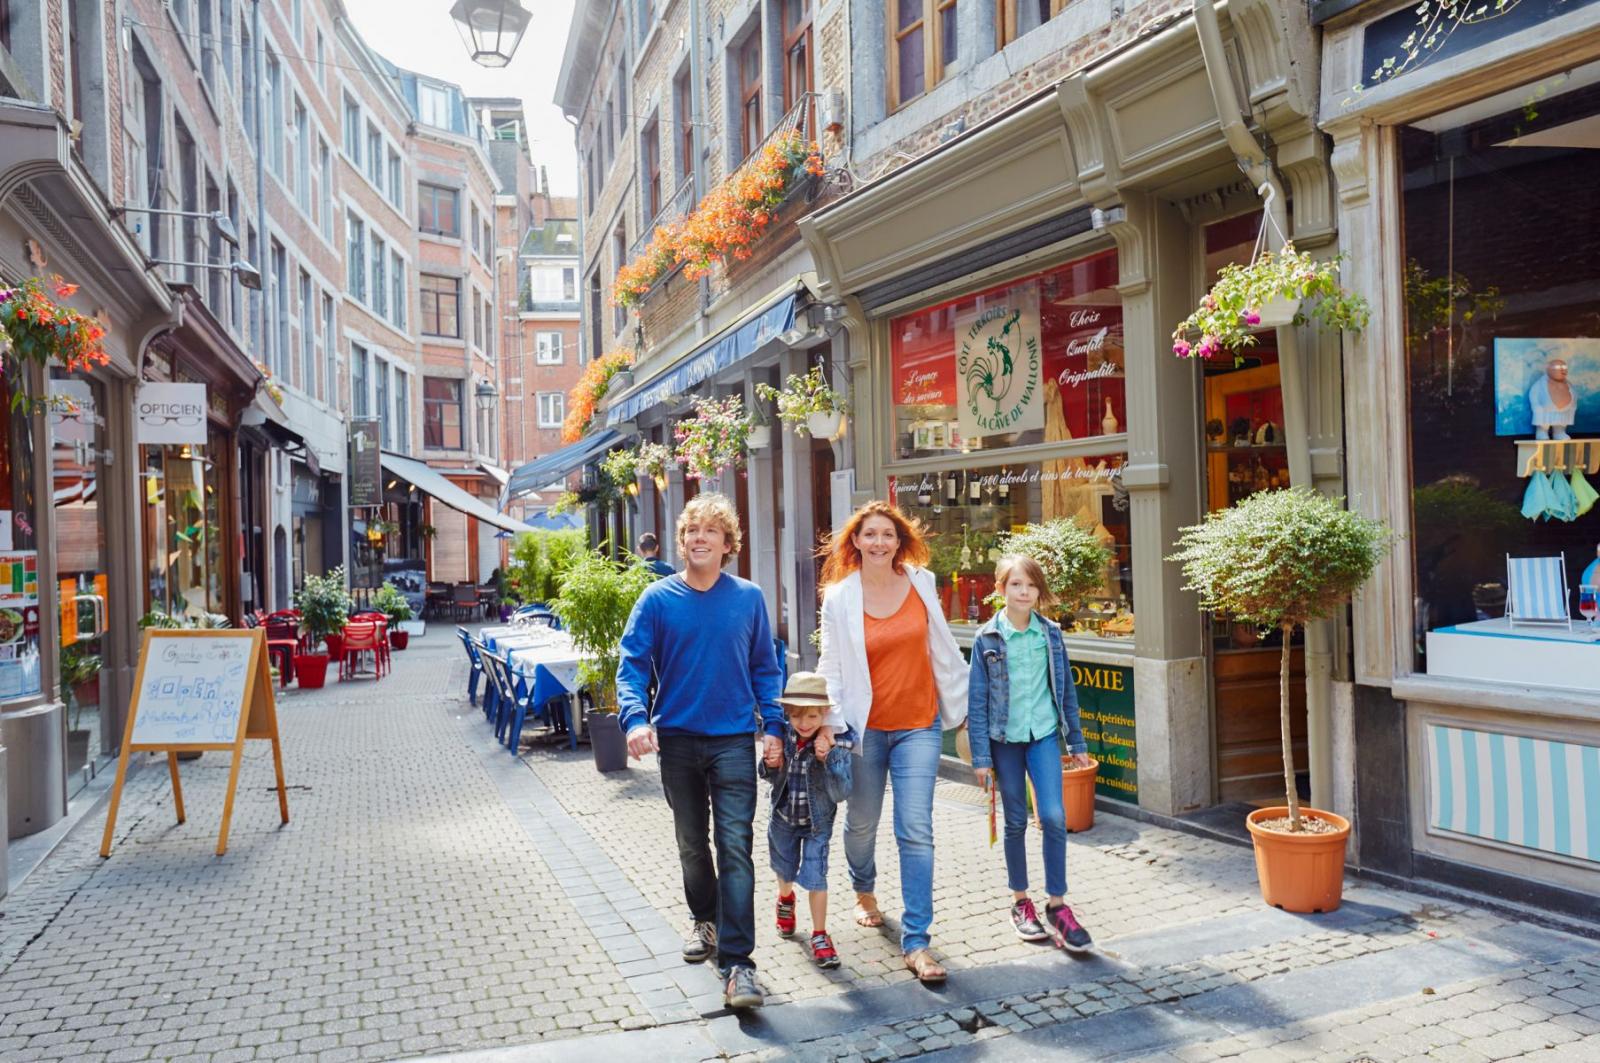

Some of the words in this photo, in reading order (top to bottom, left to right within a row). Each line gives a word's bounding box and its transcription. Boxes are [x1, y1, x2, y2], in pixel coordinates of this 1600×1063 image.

[1069, 309, 1101, 328] Choix
[1058, 361, 1116, 388] Originalité
[977, 415, 987, 429] LA
[988, 414, 1011, 431] CAVE
[1010, 404, 1024, 422] DE
[1020, 336, 1039, 405] WALLONIE
[140, 403, 203, 415] OPTICIEN
[1000, 469, 1028, 485] alcools
[1030, 470, 1040, 483] et
[1041, 472, 1058, 481] vins
[1061, 465, 1072, 479] de
[1075, 466, 1094, 478] tous
[1096, 711, 1135, 727] Apéritives
[1101, 731, 1136, 748] Cadeaux
[1106, 754, 1137, 769] Alcools
[1106, 777, 1137, 792] cuisinés
